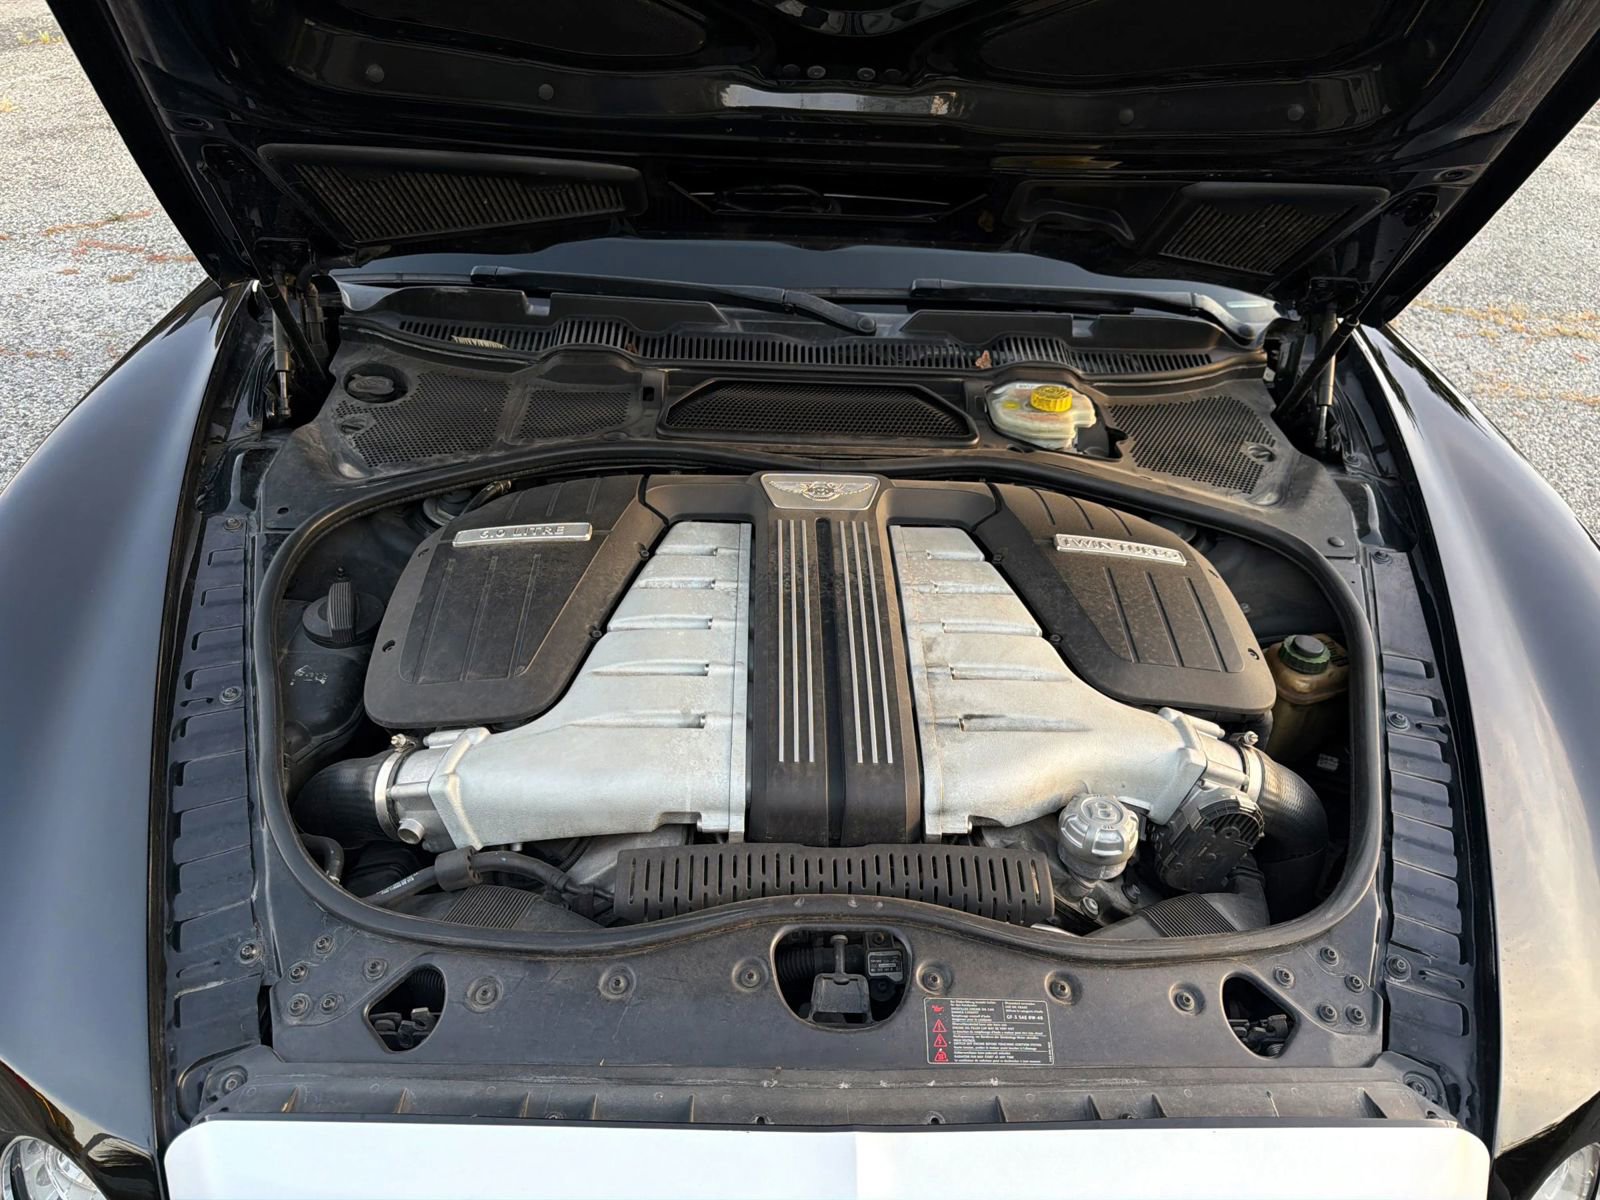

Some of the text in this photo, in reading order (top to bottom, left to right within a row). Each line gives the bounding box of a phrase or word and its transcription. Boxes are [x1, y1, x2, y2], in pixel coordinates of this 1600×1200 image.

[480, 526, 565, 539] 6.0 LITRE
[1060, 537, 1179, 559] TWIN TURBO
